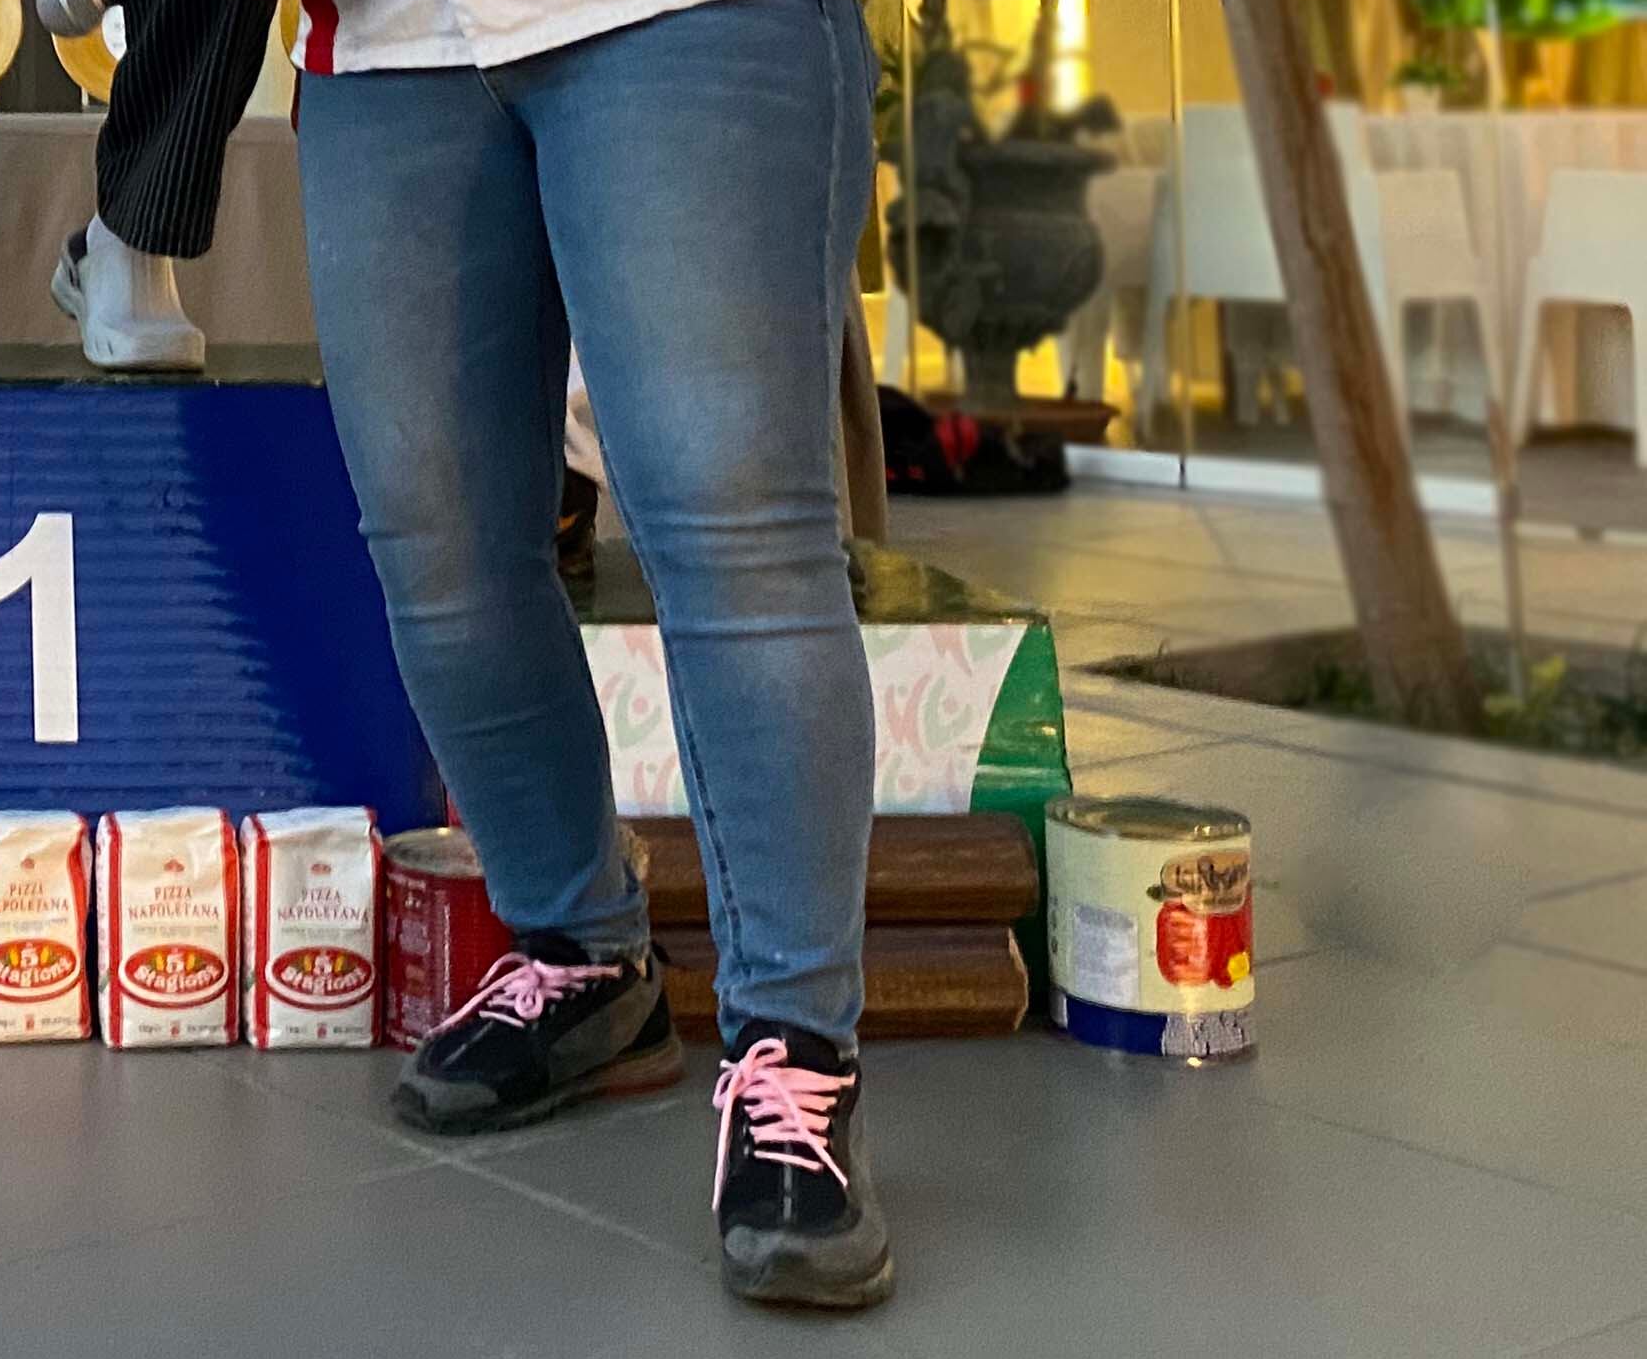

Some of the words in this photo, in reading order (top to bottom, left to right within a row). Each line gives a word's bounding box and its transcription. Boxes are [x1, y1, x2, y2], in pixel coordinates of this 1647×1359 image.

[8, 881, 45, 898] PIZZA
[153, 885, 194, 901] PIZZA
[300, 886, 343, 904] PIZZA
[127, 902, 221, 922] NAPOLETANA
[276, 904, 370, 924] NAPOLETANA
